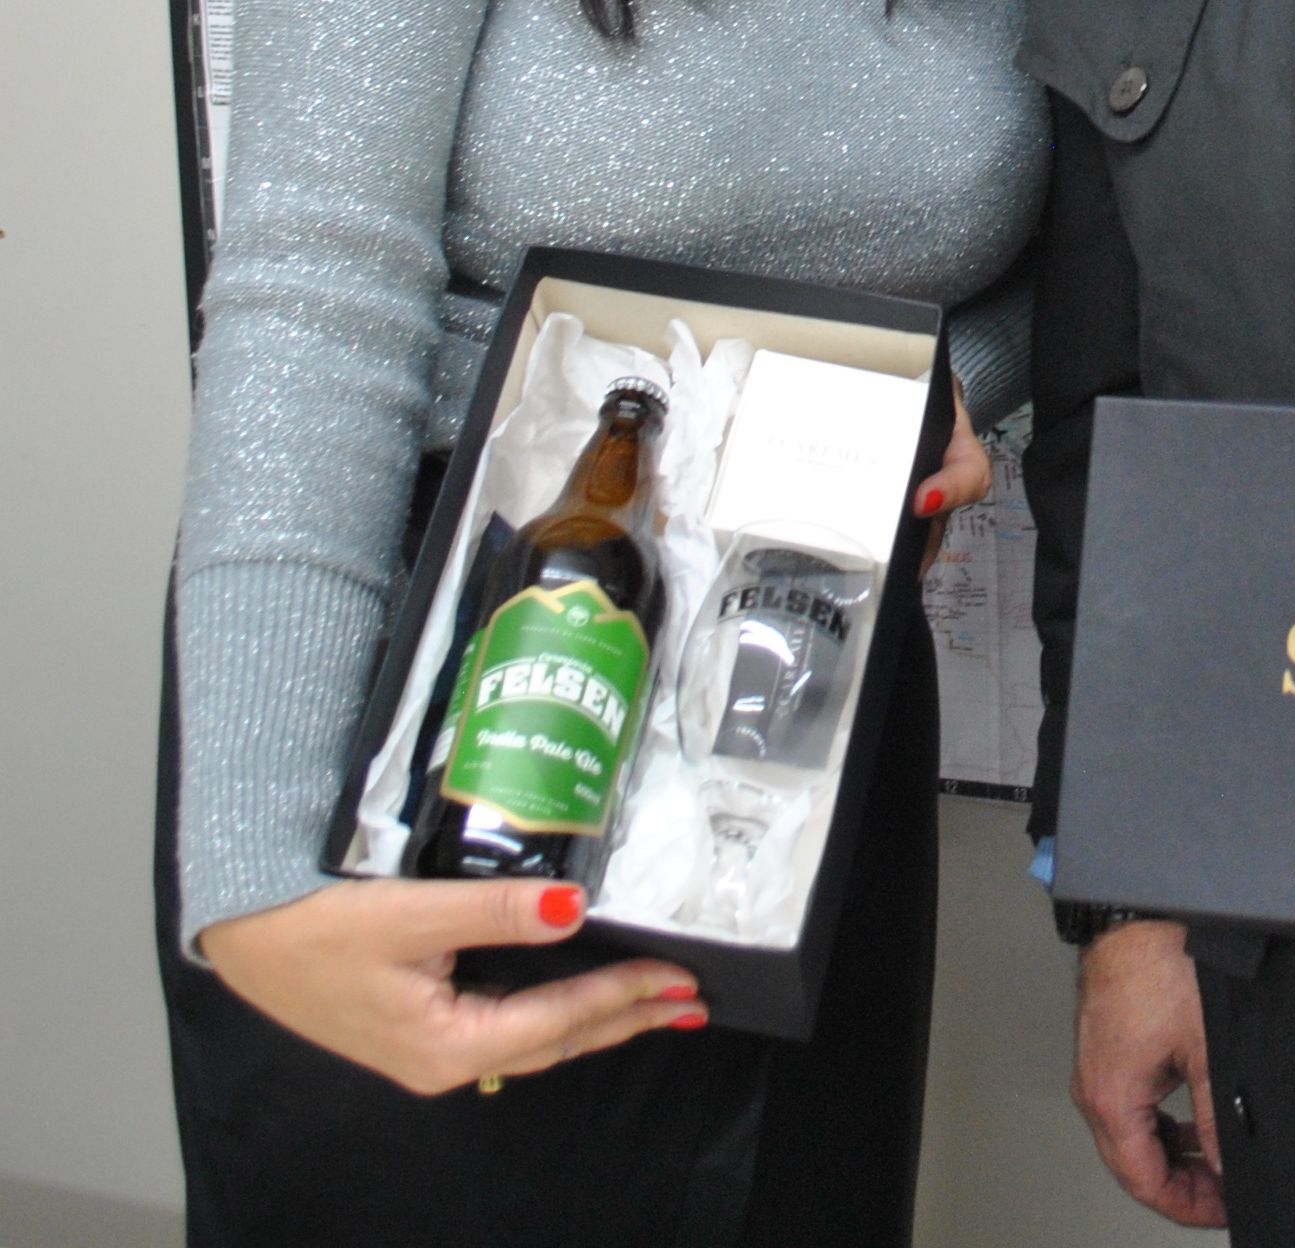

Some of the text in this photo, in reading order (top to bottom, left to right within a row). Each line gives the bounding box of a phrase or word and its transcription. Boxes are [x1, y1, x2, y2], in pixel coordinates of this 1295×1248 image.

[717, 585, 852, 643] FELSEN
[475, 662, 627, 747] FELSEN
[529, 733, 574, 761] Pale
